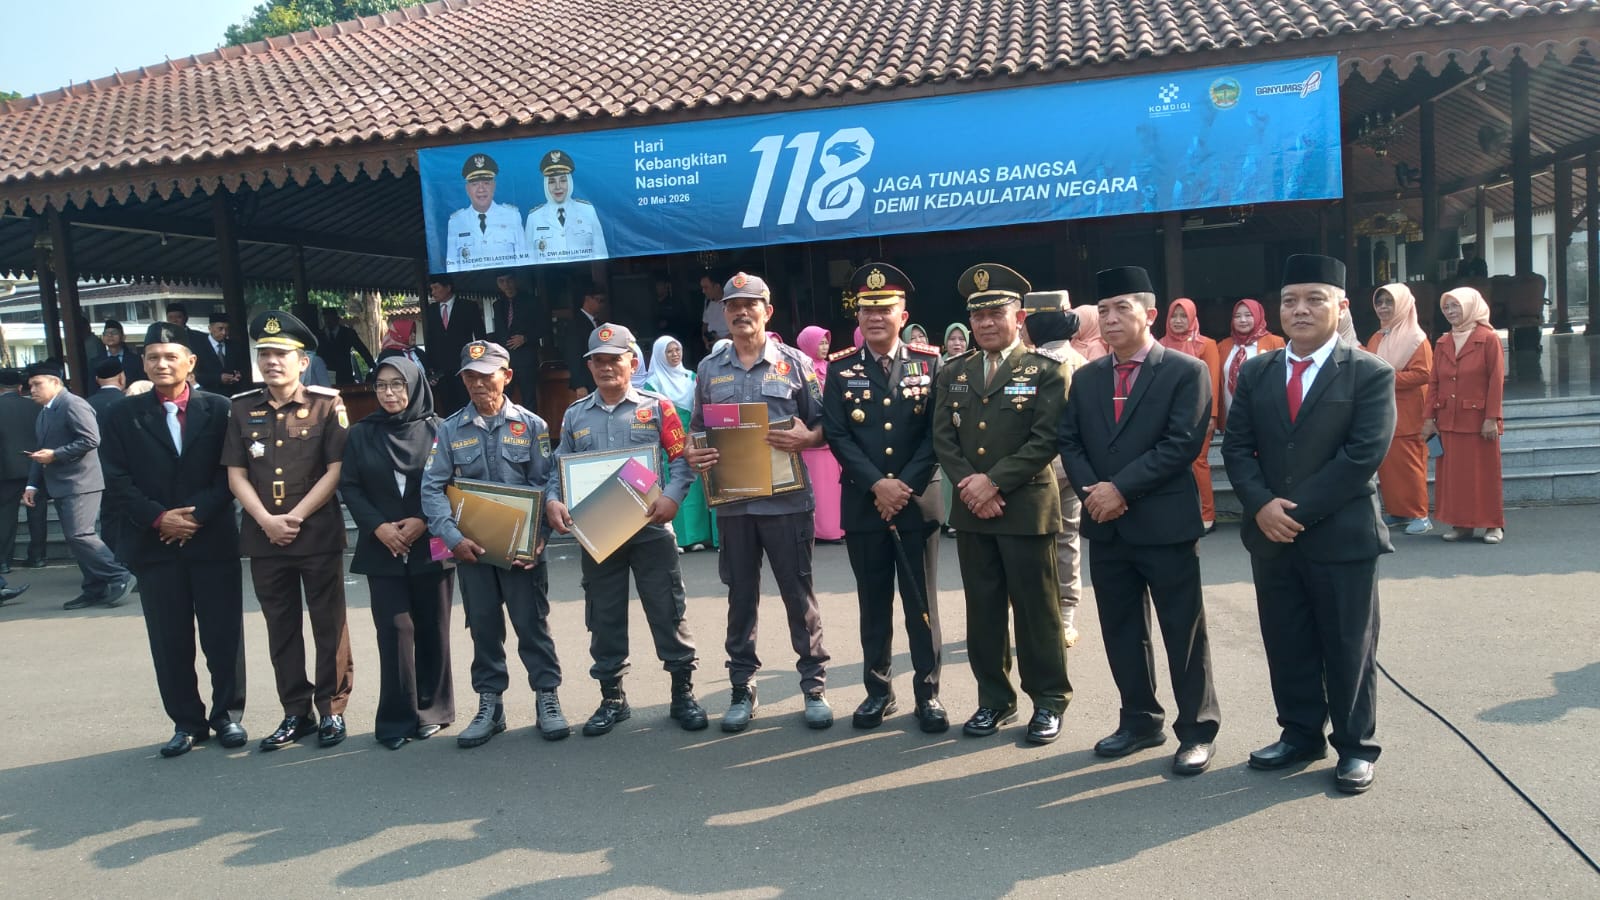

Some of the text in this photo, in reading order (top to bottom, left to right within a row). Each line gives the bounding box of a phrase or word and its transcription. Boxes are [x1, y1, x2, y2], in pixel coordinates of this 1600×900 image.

[1256, 83, 1303, 95] BANYUMAS
[1149, 102, 1191, 113] KOMDIGI
[634, 139, 664, 154] Hari
[634, 152, 728, 172] Kebangkitan
[635, 172, 700, 190] Nasional
[743, 126, 875, 230] 118
[873, 160, 1077, 194] JAGA TUNAS BANGSA
[637, 194, 691, 206] 20 Mei 2026
[874, 176, 1138, 215] DEMI KEDAULATAN NEGARA
